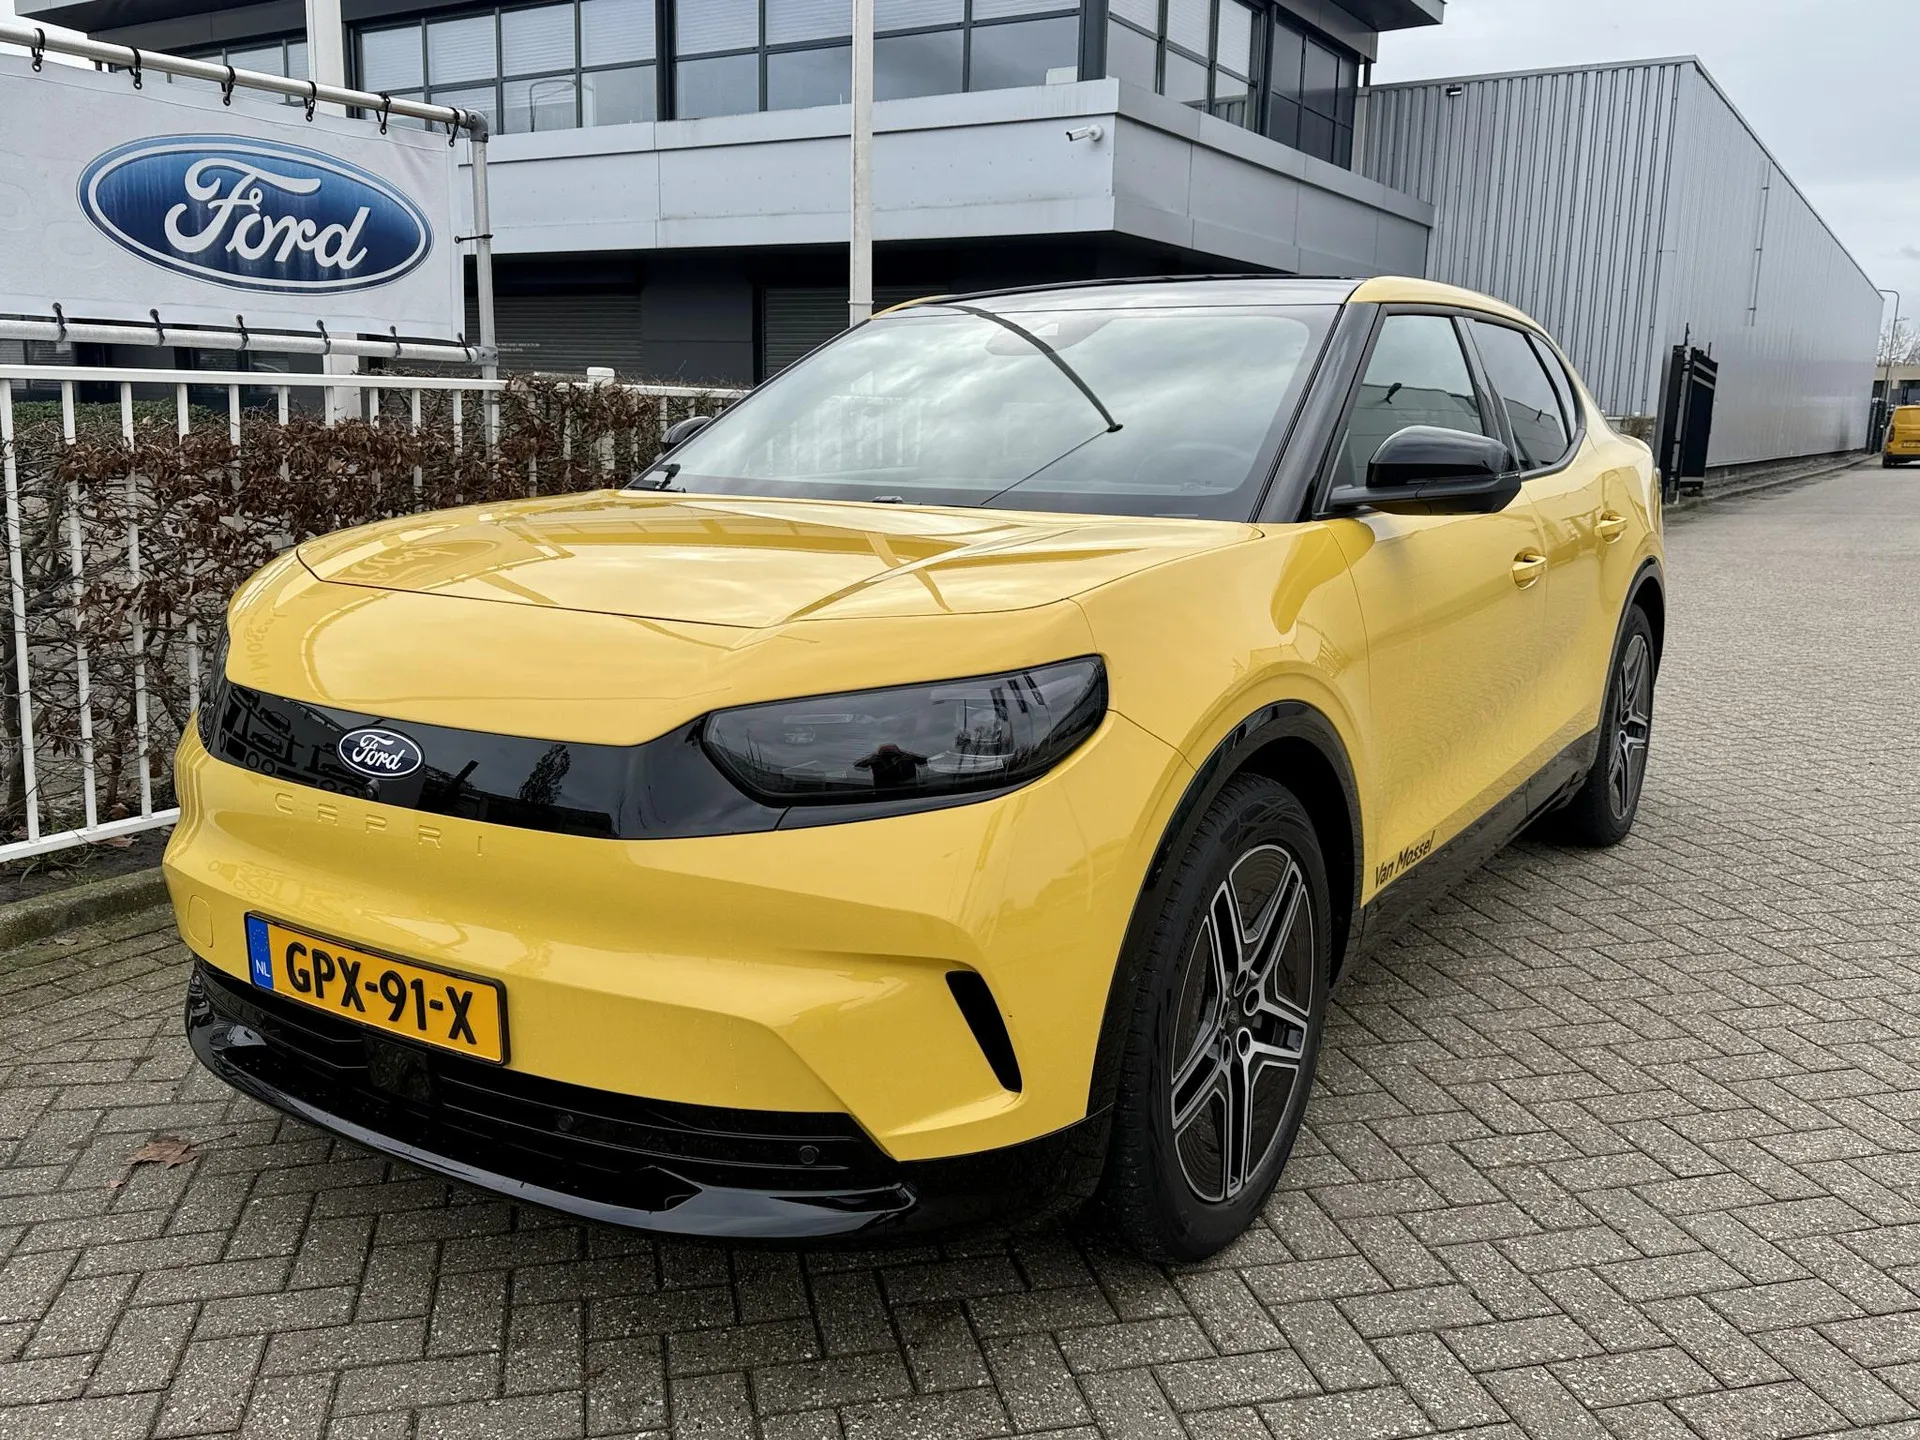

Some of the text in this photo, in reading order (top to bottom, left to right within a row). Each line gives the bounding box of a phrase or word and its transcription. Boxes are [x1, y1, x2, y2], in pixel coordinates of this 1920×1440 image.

[164, 157, 371, 270] Ford
[352, 734, 406, 770] Ford
[274, 792, 484, 858] CAPRI
[1374, 828, 1436, 889] Van Mossel
[255, 959, 271, 979] NL
[285, 941, 478, 1046] GPX-91-X
